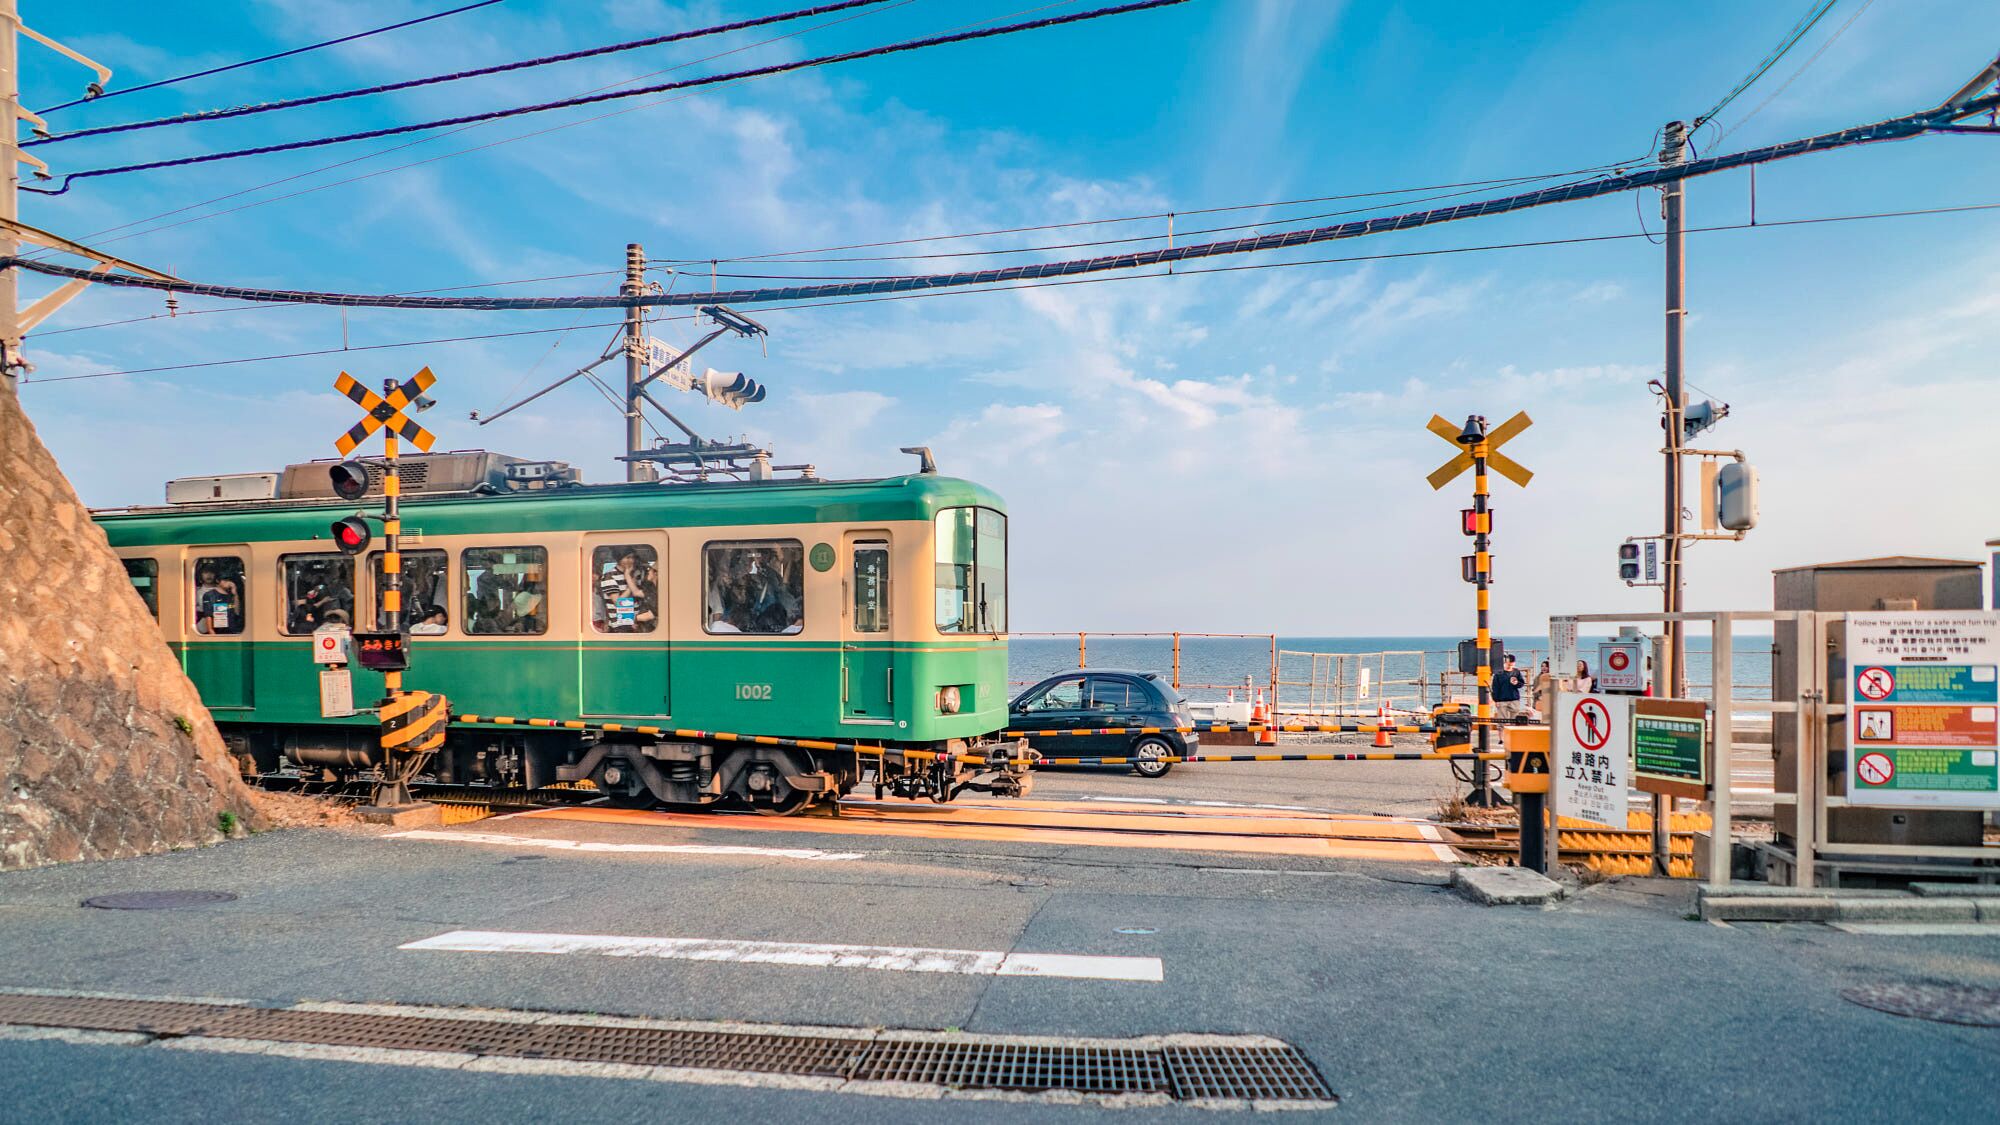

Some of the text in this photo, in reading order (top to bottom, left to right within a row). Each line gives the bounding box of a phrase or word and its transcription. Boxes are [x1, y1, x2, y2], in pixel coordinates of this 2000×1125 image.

[735, 684, 772, 700] 1002
[390, 720, 396, 728] 2
[1572, 751, 1609, 769] 線路内
[1565, 766, 1616, 786] 立入禁止
[1578, 783, 1604, 793] Keep Out
